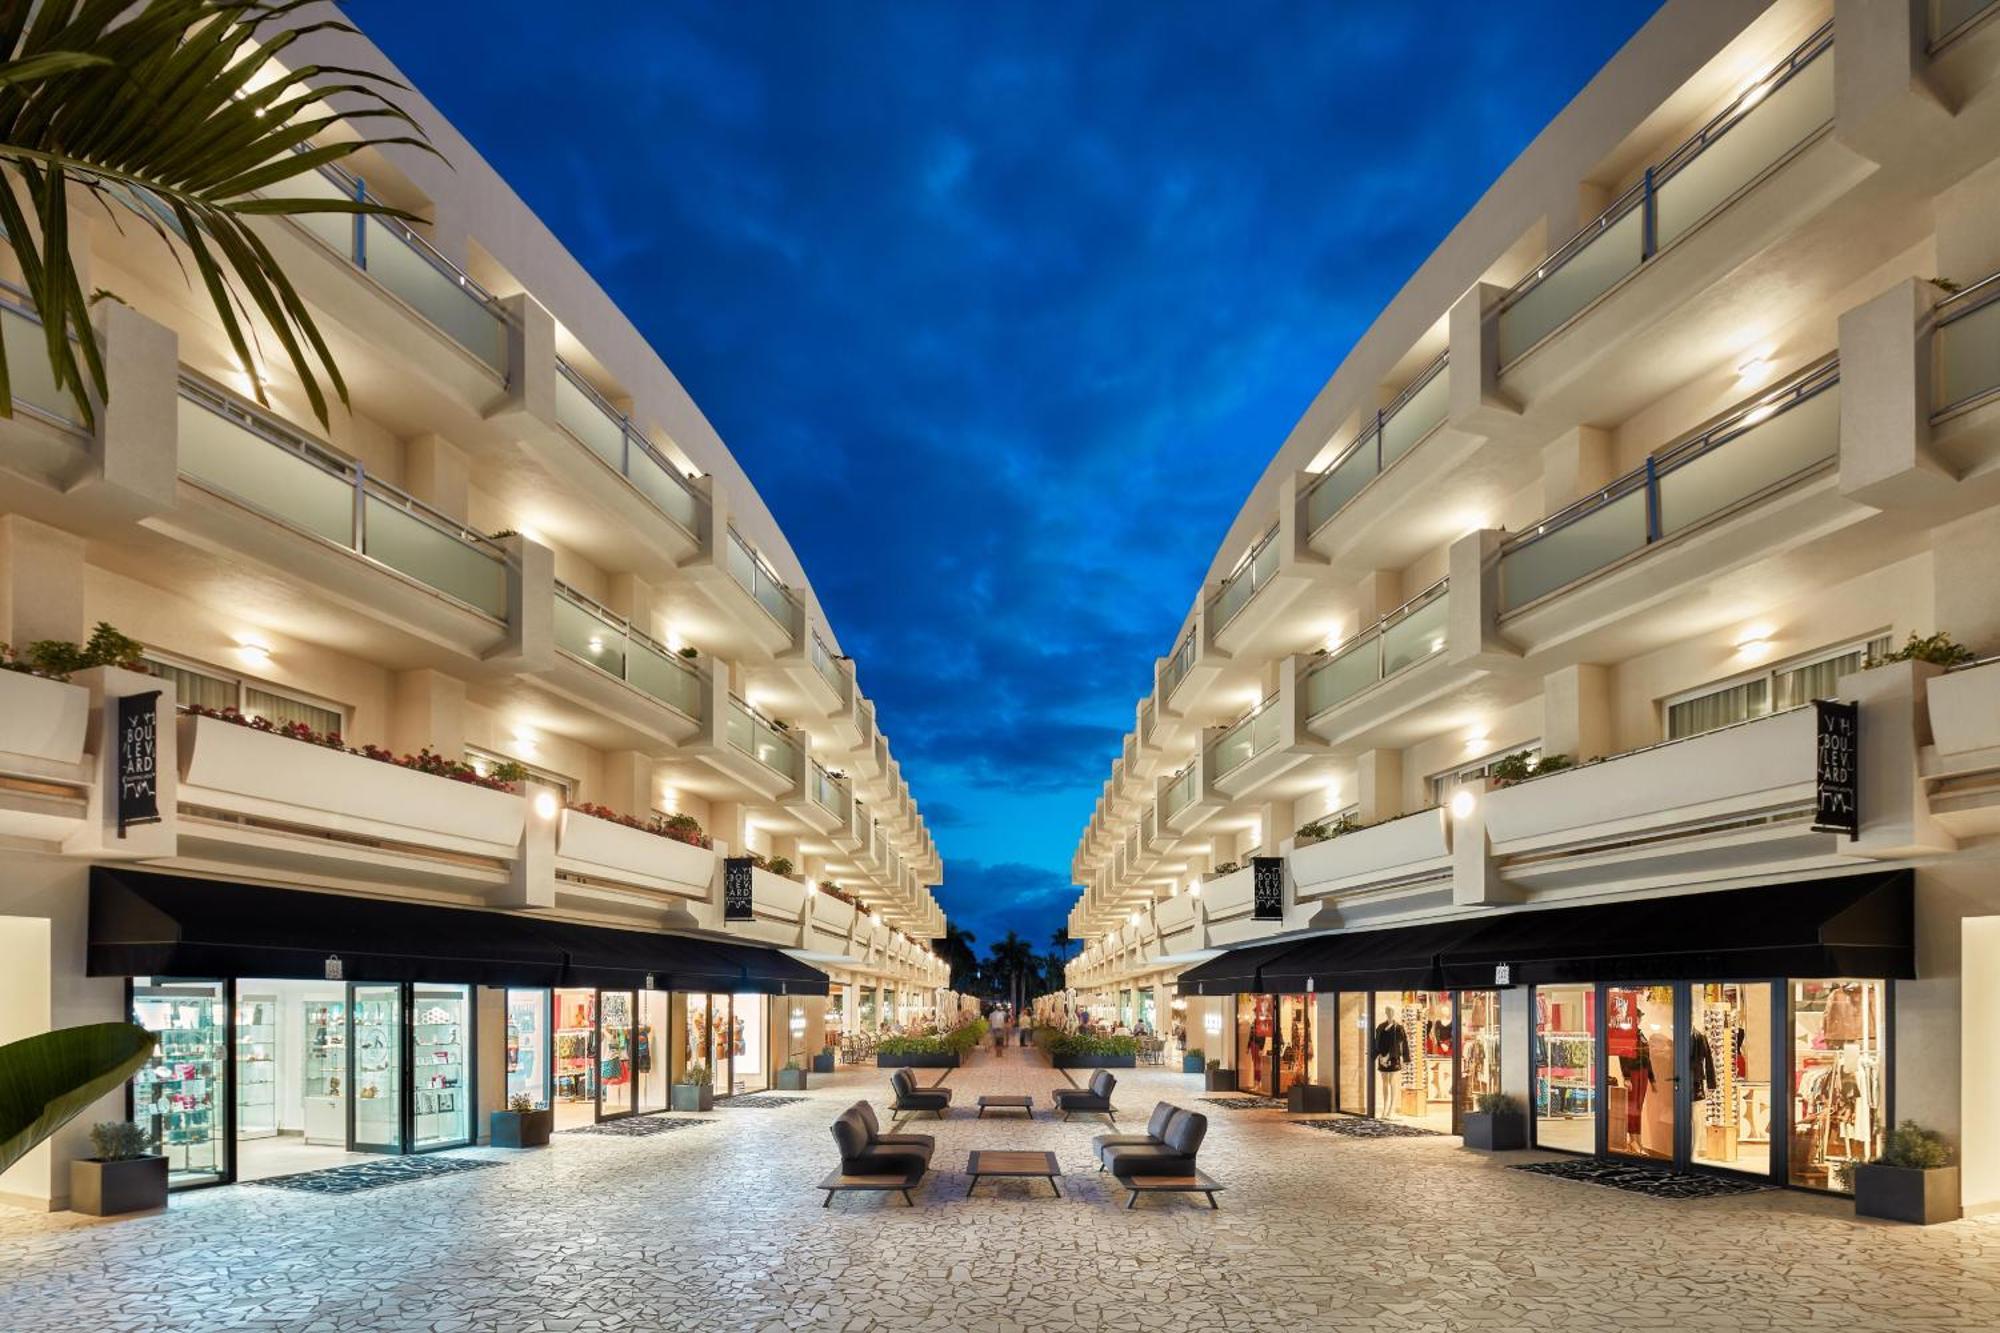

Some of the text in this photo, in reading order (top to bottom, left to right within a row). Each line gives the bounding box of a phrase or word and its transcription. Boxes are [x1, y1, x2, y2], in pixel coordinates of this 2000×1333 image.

[127, 726, 152, 743] BOU
[1824, 733, 1848, 751] BOU
[127, 742, 153, 758] LEV
[1824, 749, 1848, 766] LEV
[126, 757, 153, 774] ARD
[1823, 767, 1848, 783] ARD
